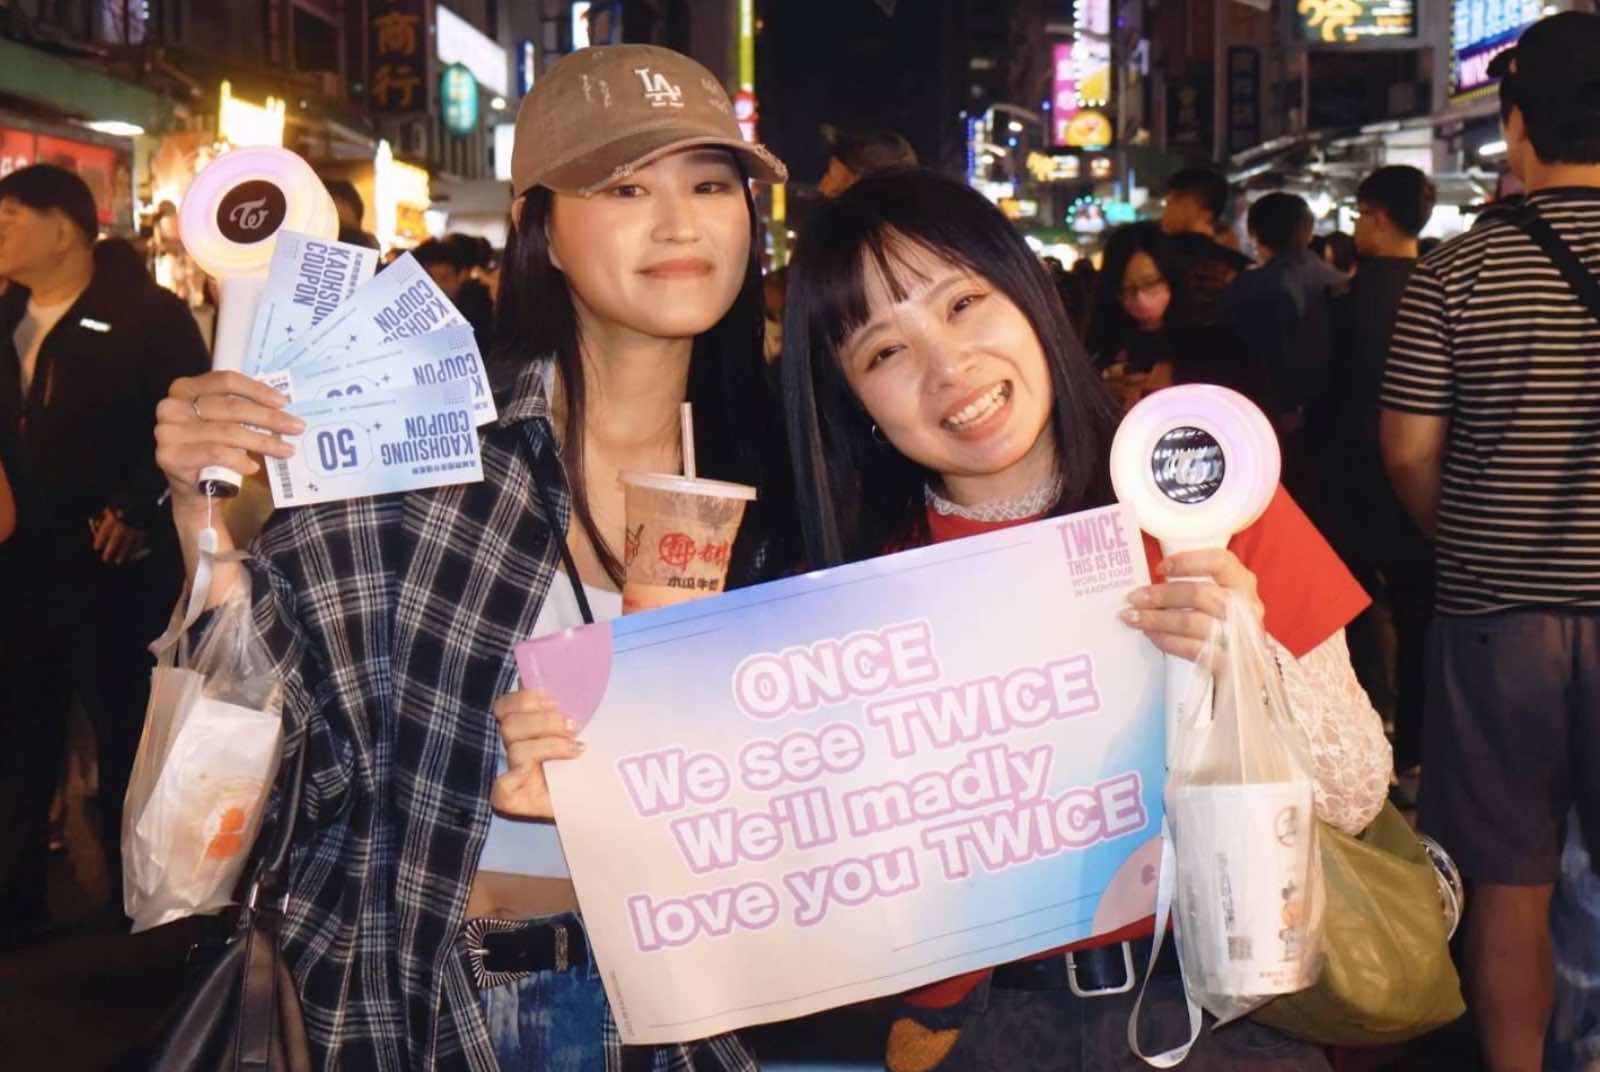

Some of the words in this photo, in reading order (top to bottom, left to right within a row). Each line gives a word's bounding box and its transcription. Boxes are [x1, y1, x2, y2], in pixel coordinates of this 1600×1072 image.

[635, 68, 685, 107] LA
[292, 241, 328, 306] COUPON
[373, 279, 435, 333] COUPON
[412, 352, 479, 386] COUPON
[404, 410, 470, 440] COUPON
[316, 428, 359, 471] 50
[380, 433, 475, 466] KAOHSIUNG
[1056, 511, 1129, 559] TWICE
[1066, 557, 1093, 577] THIS
[1095, 554, 1108, 571] IS
[736, 621, 938, 718] ONCE
[618, 748, 731, 817] We
[739, 723, 865, 791] see
[866, 655, 1100, 757] TWICE
[671, 786, 837, 874] We'll
[843, 744, 1053, 836] madly
[628, 881, 779, 951] love
[783, 847, 920, 926] you
[921, 773, 1146, 879] TWICE
